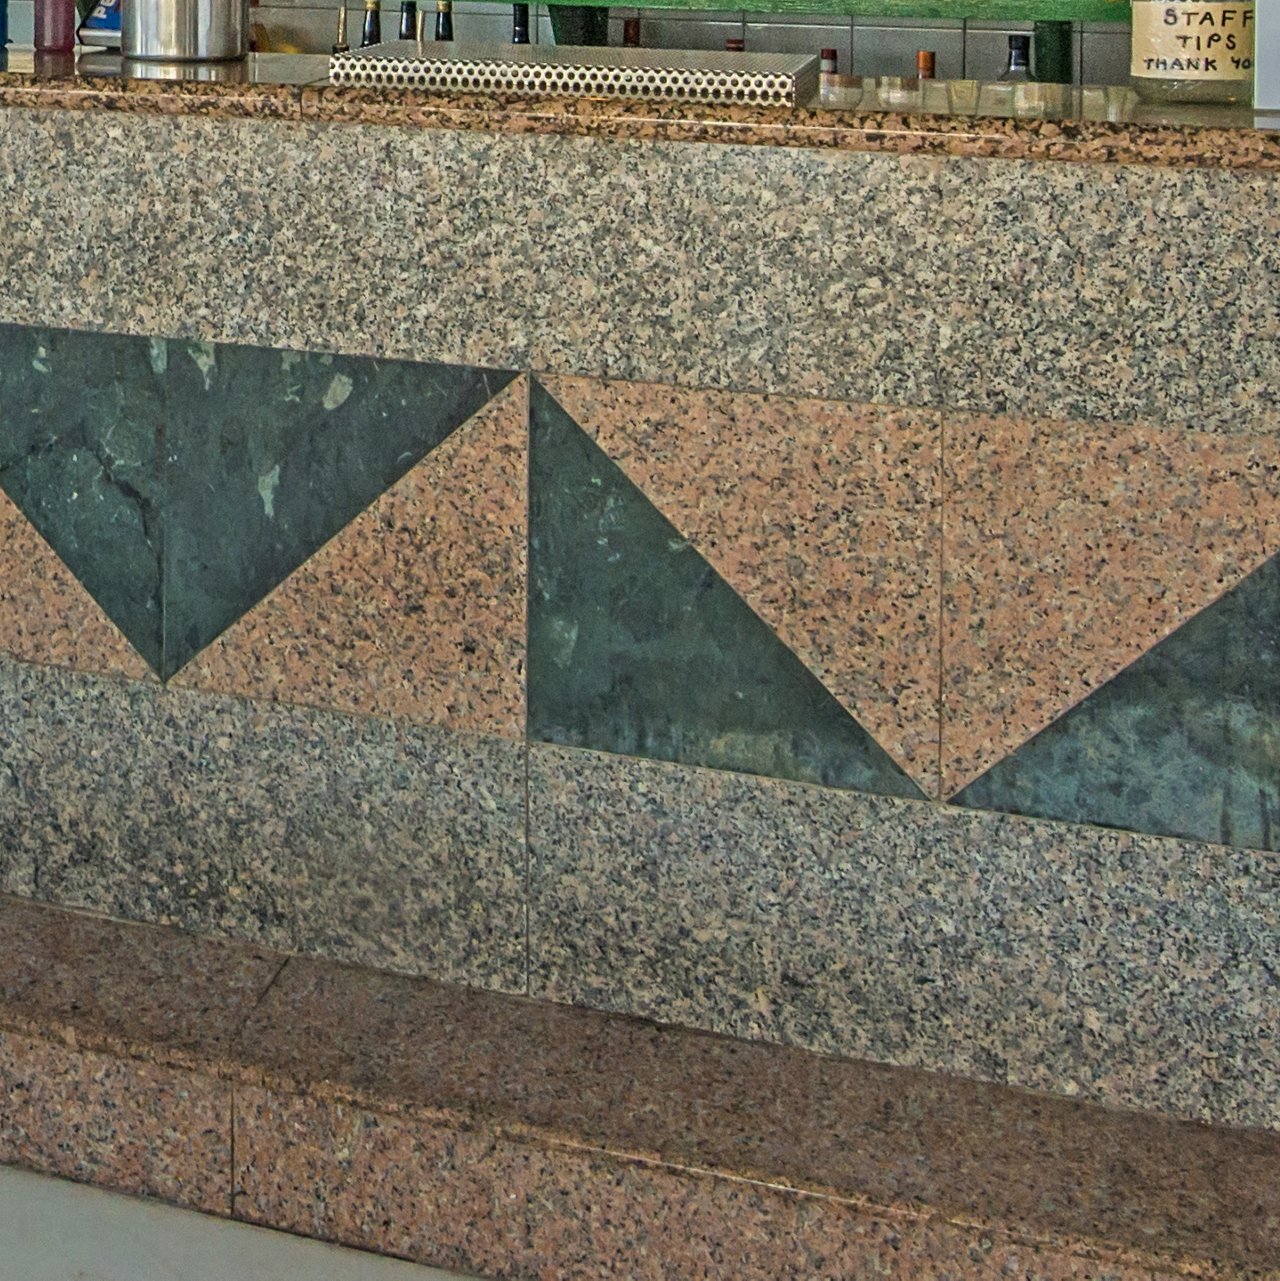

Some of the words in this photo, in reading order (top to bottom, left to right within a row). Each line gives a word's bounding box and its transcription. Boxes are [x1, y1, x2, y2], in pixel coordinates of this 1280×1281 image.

[1164, 9, 1254, 26] STAFF
[1176, 34, 1237, 51] TIPS
[1144, 58, 1217, 71] THANK
